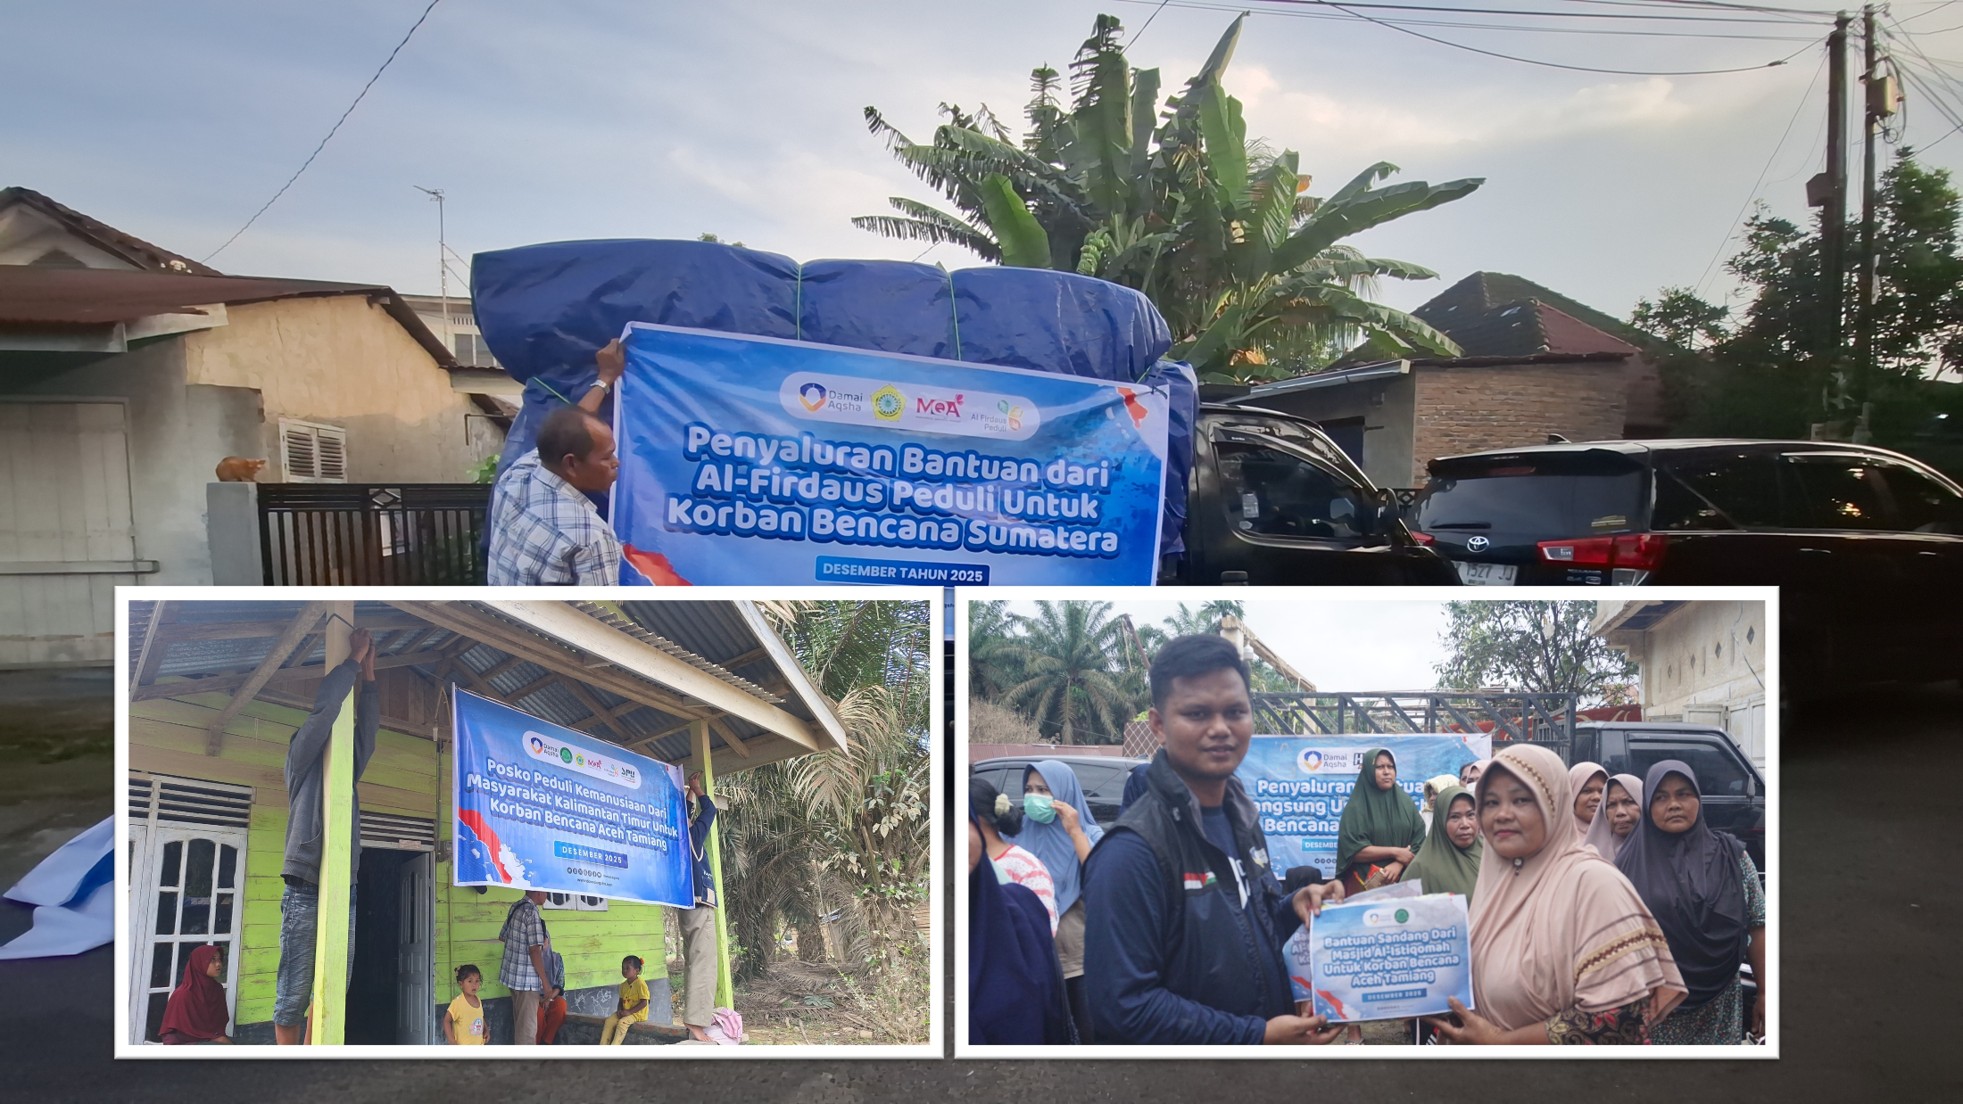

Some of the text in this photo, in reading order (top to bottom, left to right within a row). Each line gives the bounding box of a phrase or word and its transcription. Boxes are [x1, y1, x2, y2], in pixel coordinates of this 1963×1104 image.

[829, 389, 863, 402] Damai
[828, 400, 862, 412] Aqsha
[971, 413, 980, 422] Al
[980, 415, 1008, 425] Firdaus
[984, 423, 1008, 433] Peduli
[687, 425, 1109, 488] Penyaluran Bantuan dari
[696, 463, 1099, 519] Al-Firdaus Peduli Untuk
[667, 496, 1119, 553] Korban Bencana Sumatera
[823, 562, 984, 583] DESEMBER TAHUN 2025
[1323, 753, 1348, 761] Damai
[487, 758, 667, 819] Posko Peduli Kemanusiaan Dari
[1257, 778, 1355, 796] Penyaluran
[466, 773, 678, 838] Masyarakat Kalimantan Timur Untuk
[490, 797, 668, 852] Korban Bencana Aceh Tamiang
[1264, 818, 1339, 832] Bencana
[562, 846, 622, 864] DESEMBER 2025
[1324, 935, 1375, 948] Bantuan
[1377, 931, 1429, 944] Sandang
[1431, 927, 1456, 940] Dari
[1332, 942, 1450, 961] Masjid Al-Istiqomah
[1324, 955, 1459, 975] Untuk Korban Bencana
[1352, 971, 1435, 987] Aceh Tamiang
